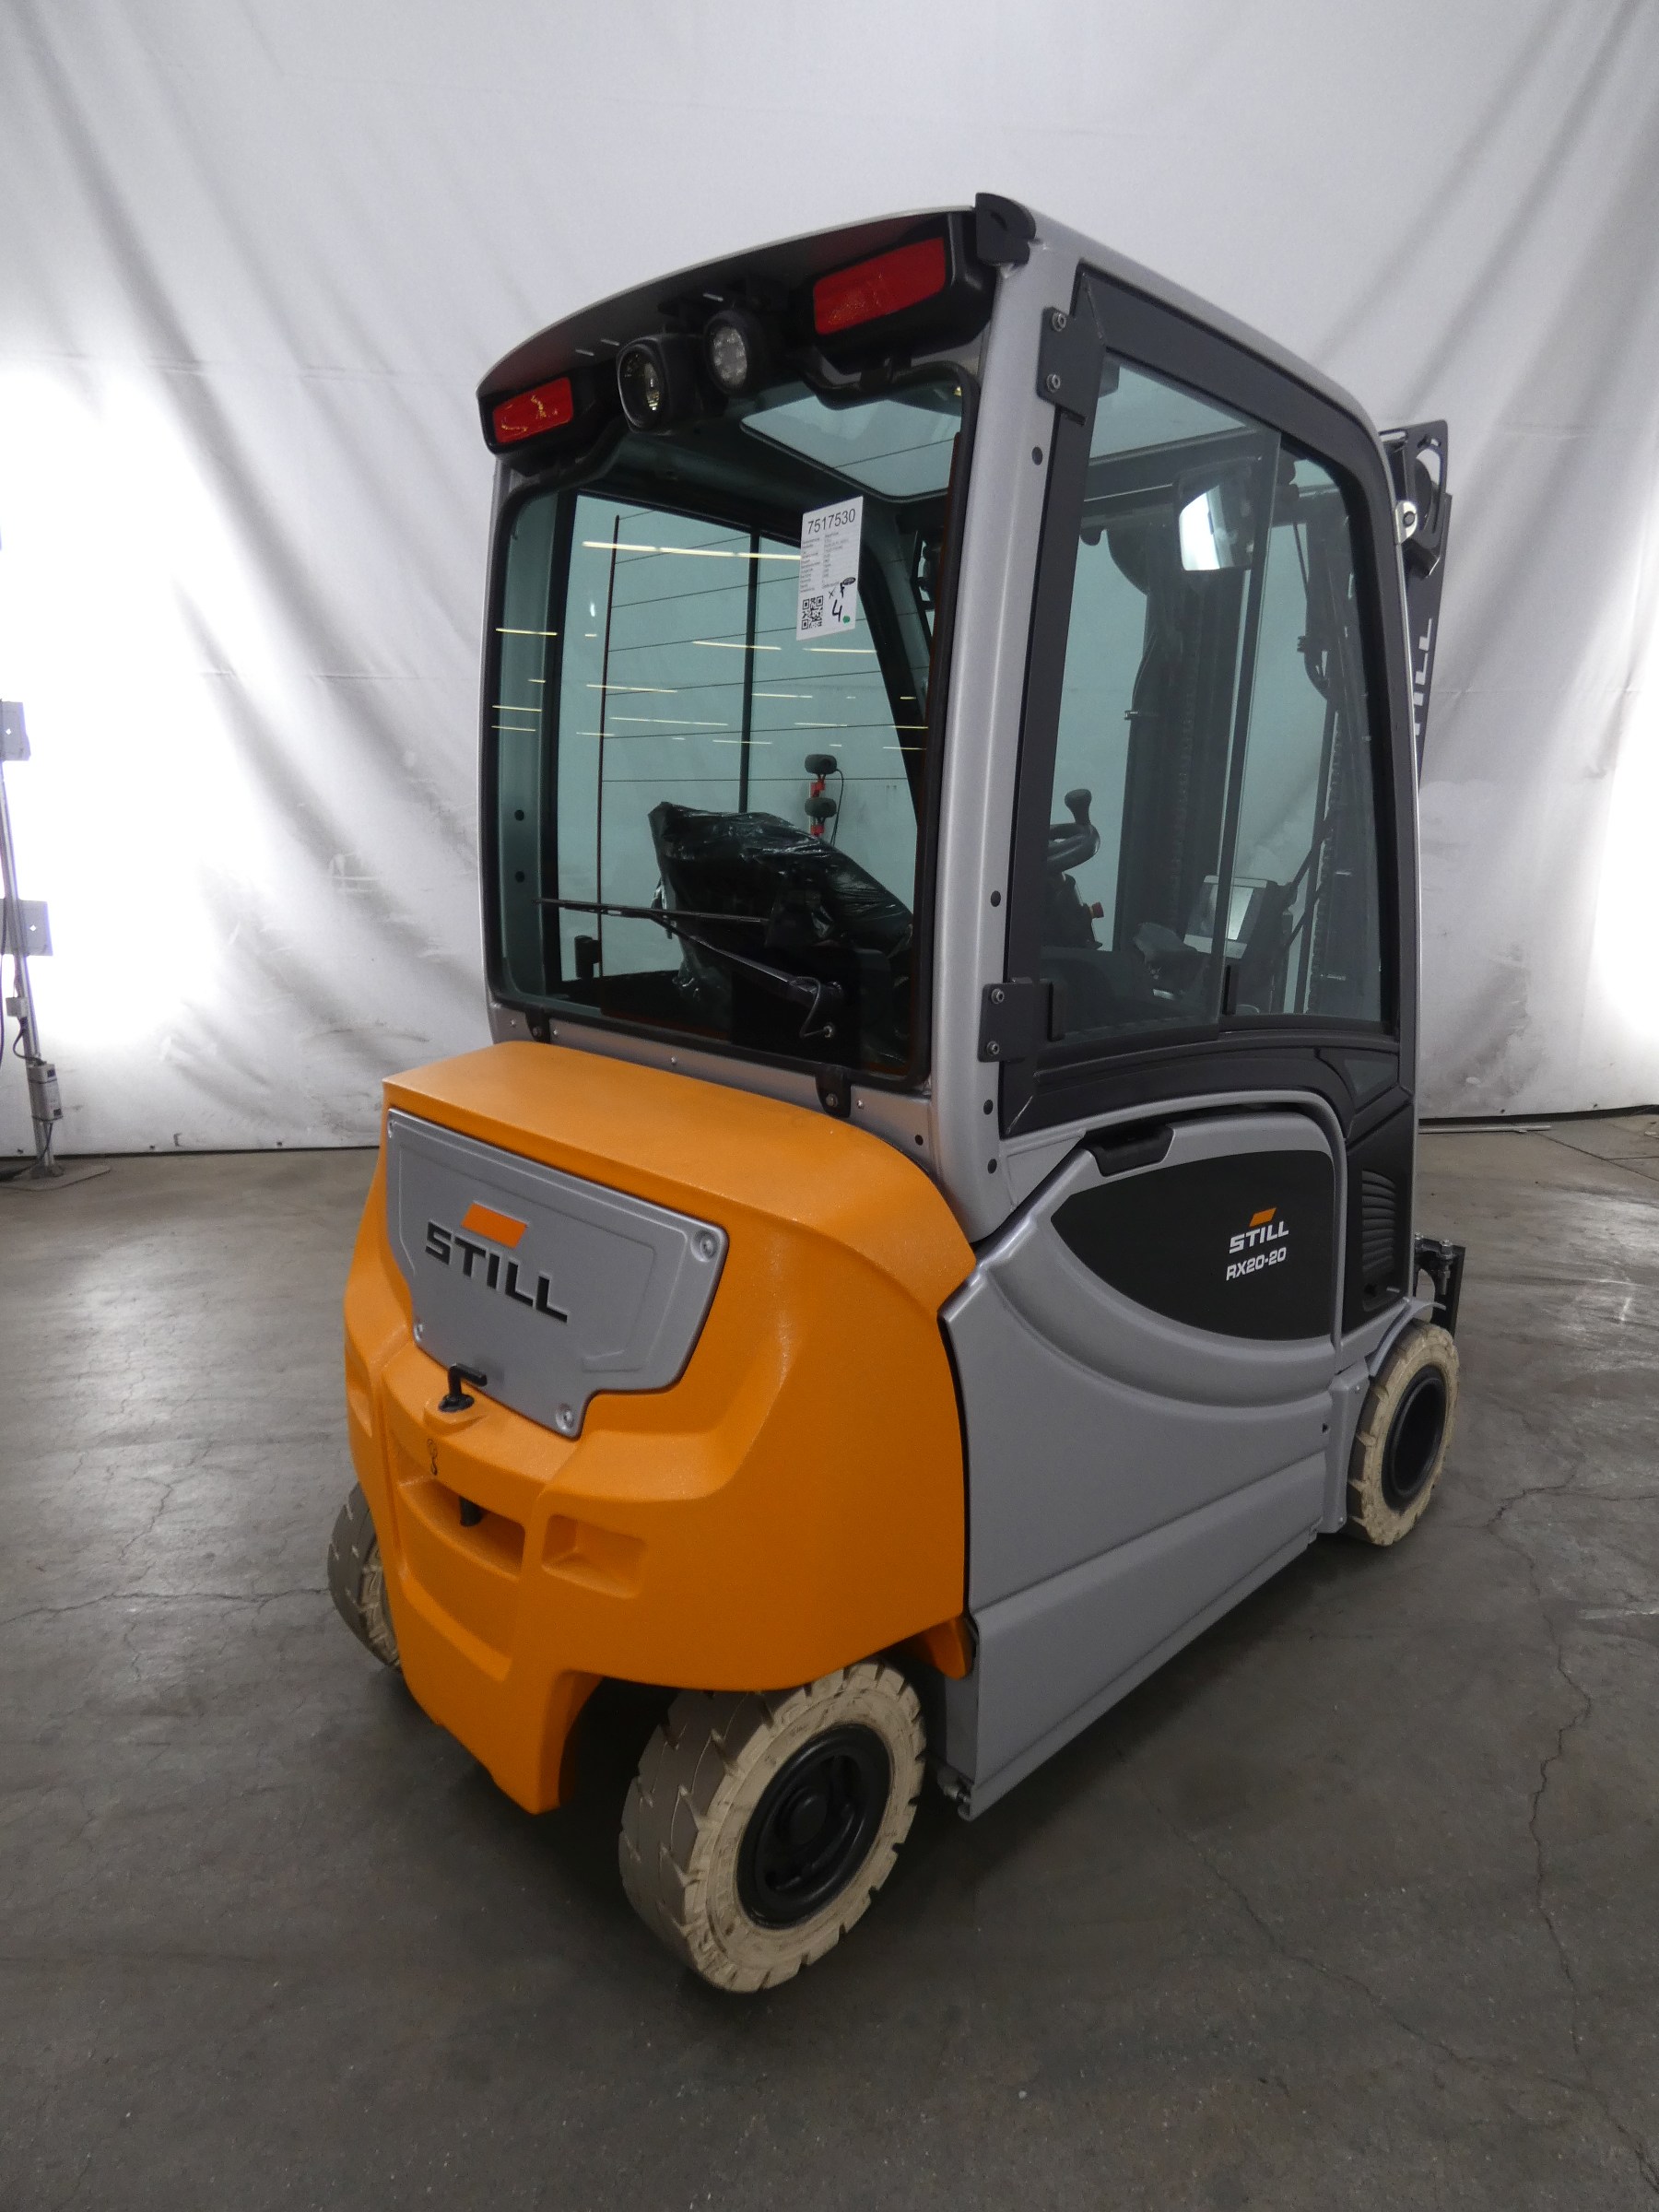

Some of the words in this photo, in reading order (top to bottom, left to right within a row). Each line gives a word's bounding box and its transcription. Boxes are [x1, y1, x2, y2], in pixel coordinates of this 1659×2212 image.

[807, 508, 856, 535] 7517530
[831, 599, 842, 622] 4
[1229, 1220, 1289, 1254] STILL
[425, 1221, 569, 1323] STILL
[1226, 1246, 1287, 1281] RX20-20
